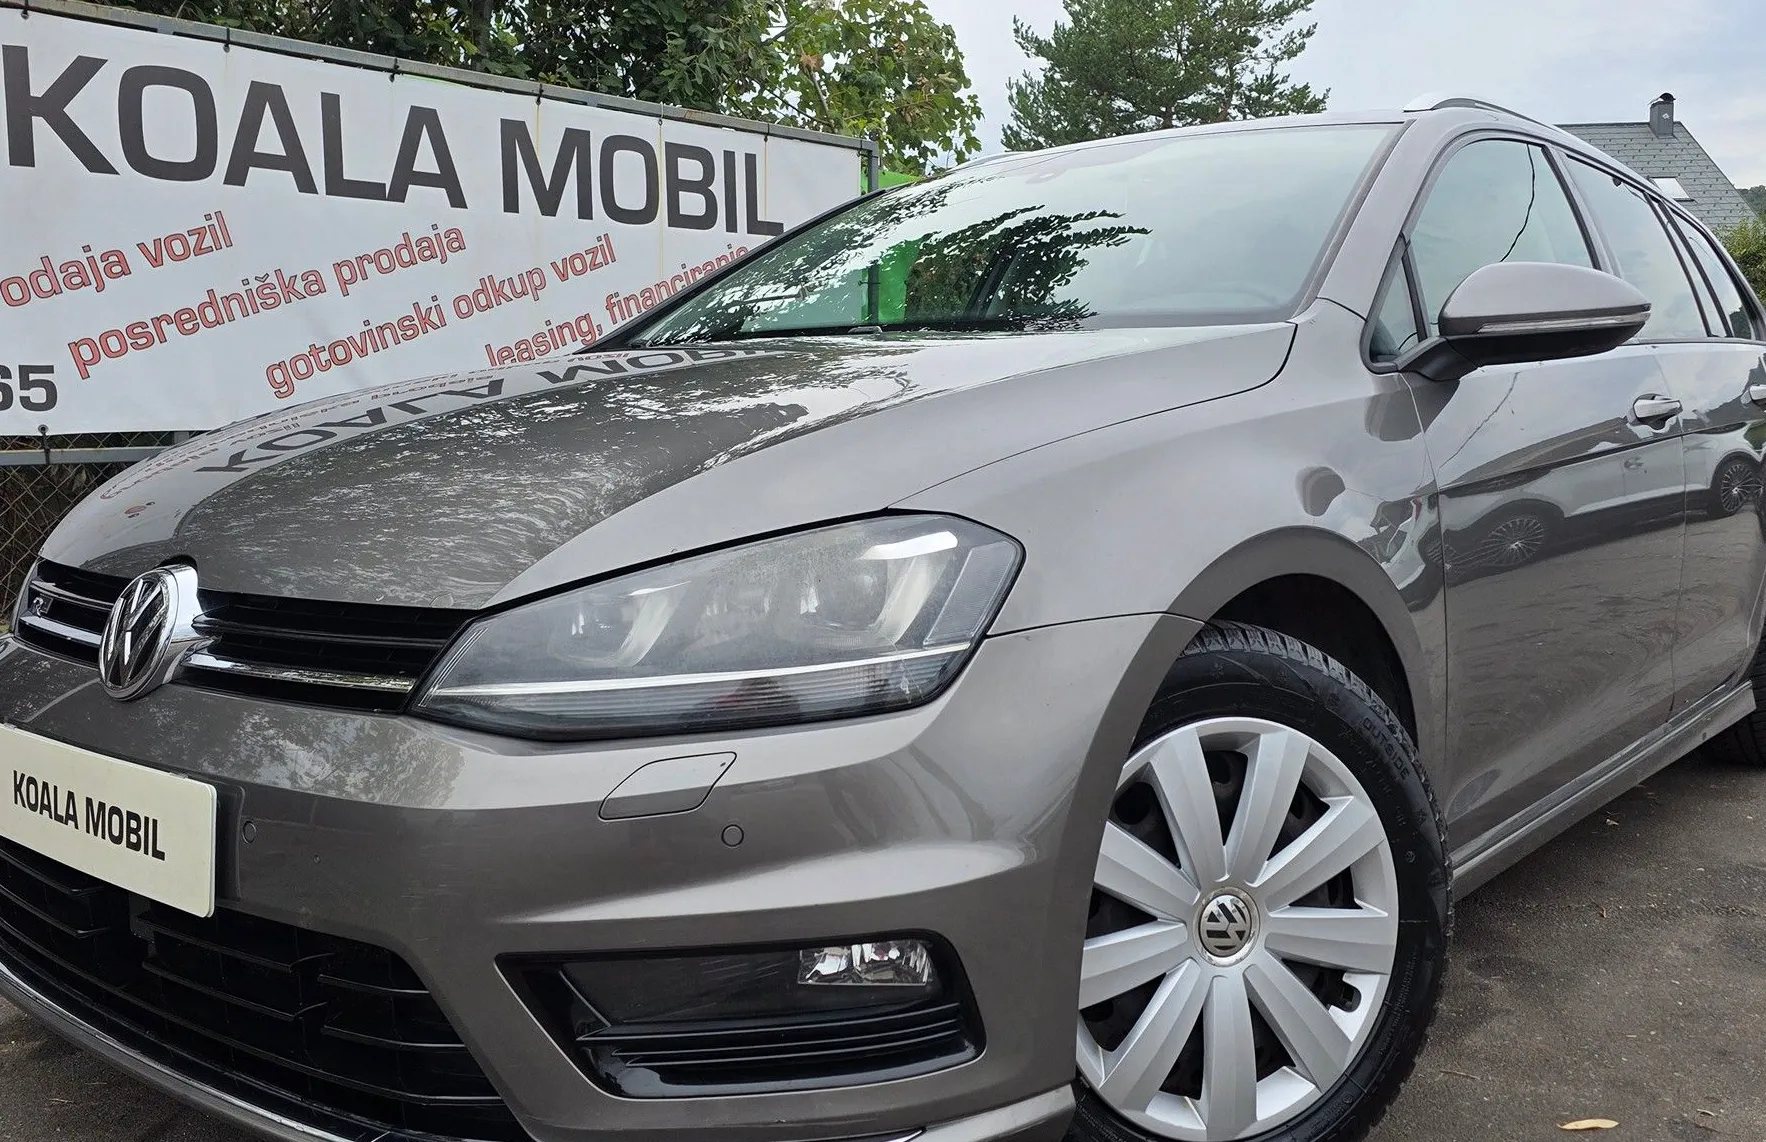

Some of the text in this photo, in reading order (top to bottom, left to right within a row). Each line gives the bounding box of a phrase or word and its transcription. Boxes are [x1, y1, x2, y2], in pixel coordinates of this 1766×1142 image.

[2, 45, 784, 236] KOALA MOBIL
[0, 211, 233, 307] odaja vozil
[68, 224, 467, 380] posredniška prodaja
[265, 296, 446, 399] gotovinski
[453, 266, 547, 319] odkup
[551, 234, 616, 282] vozil
[485, 313, 603, 366] leasing,
[13, 769, 165, 861] KOALA MOBIL
